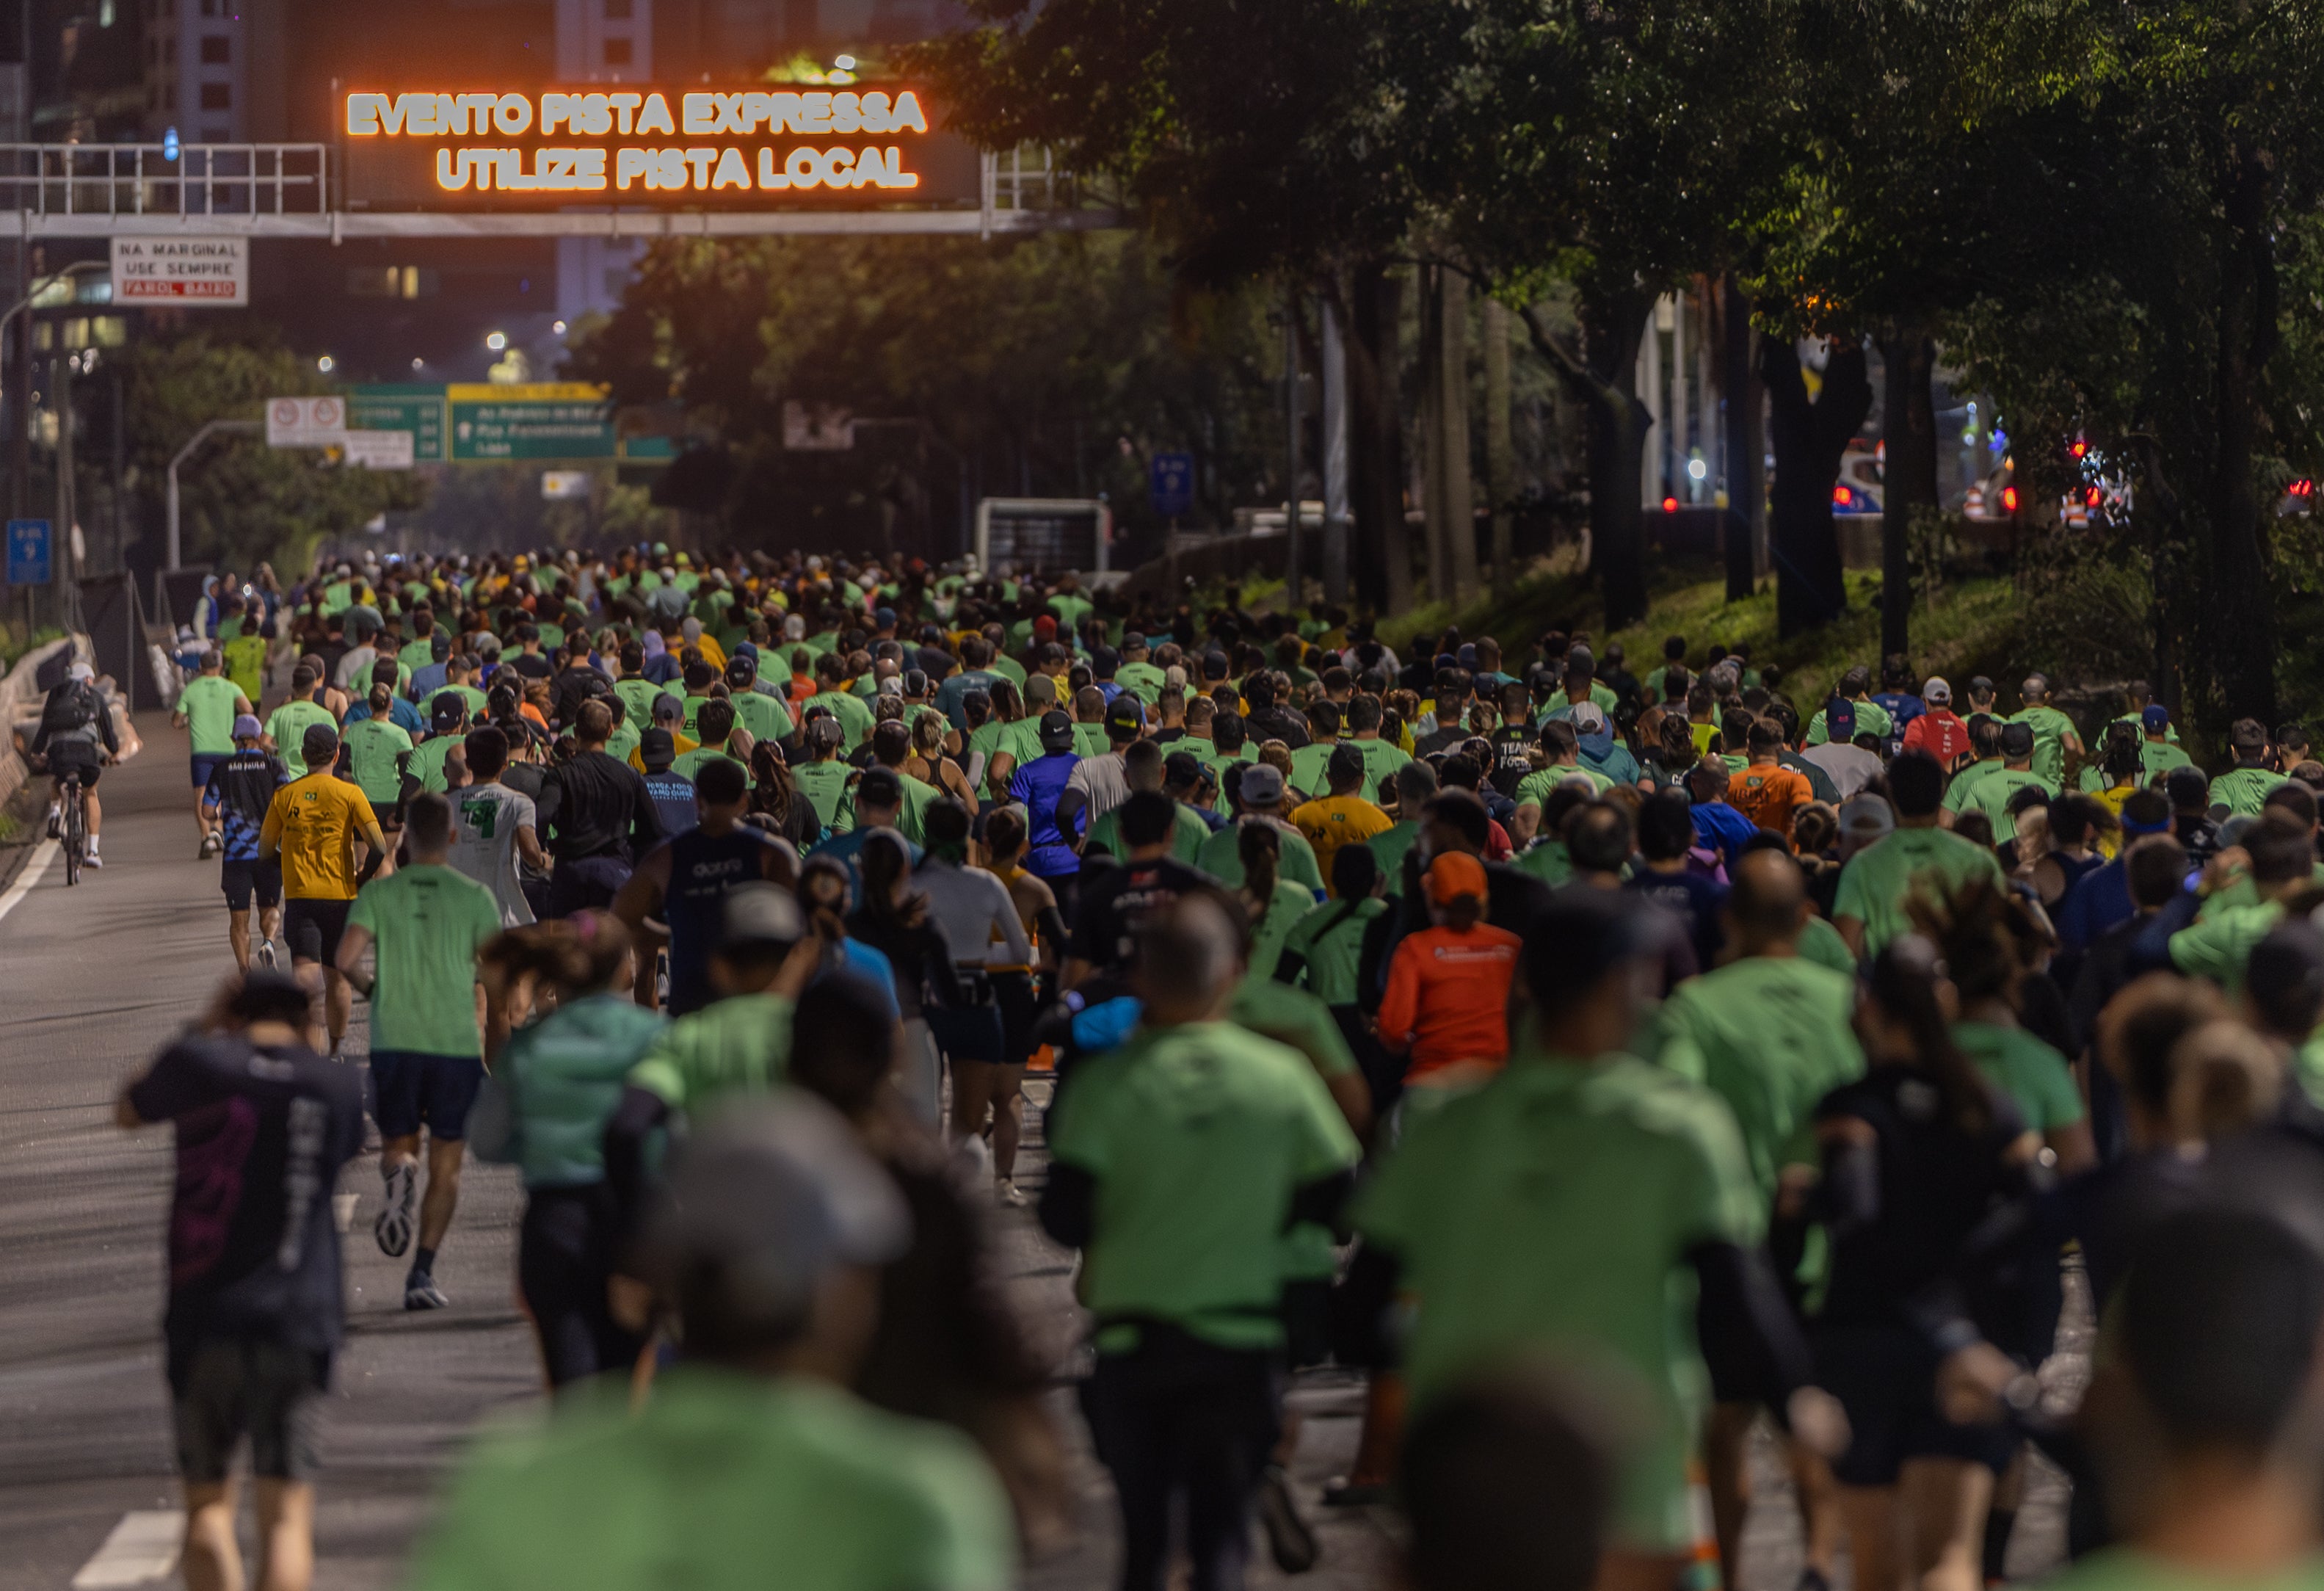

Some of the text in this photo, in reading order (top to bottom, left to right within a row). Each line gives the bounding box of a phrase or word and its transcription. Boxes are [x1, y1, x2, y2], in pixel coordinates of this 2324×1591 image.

[346, 91, 928, 135] EVENTO PISTA EXPRESSA
[436, 146, 918, 190] UTILIZE PISTA LOCAL
[120, 244, 236, 256] NA MARGINAL
[126, 262, 233, 275] USE SEMPRE
[244, 761, 265, 771] PAULO
